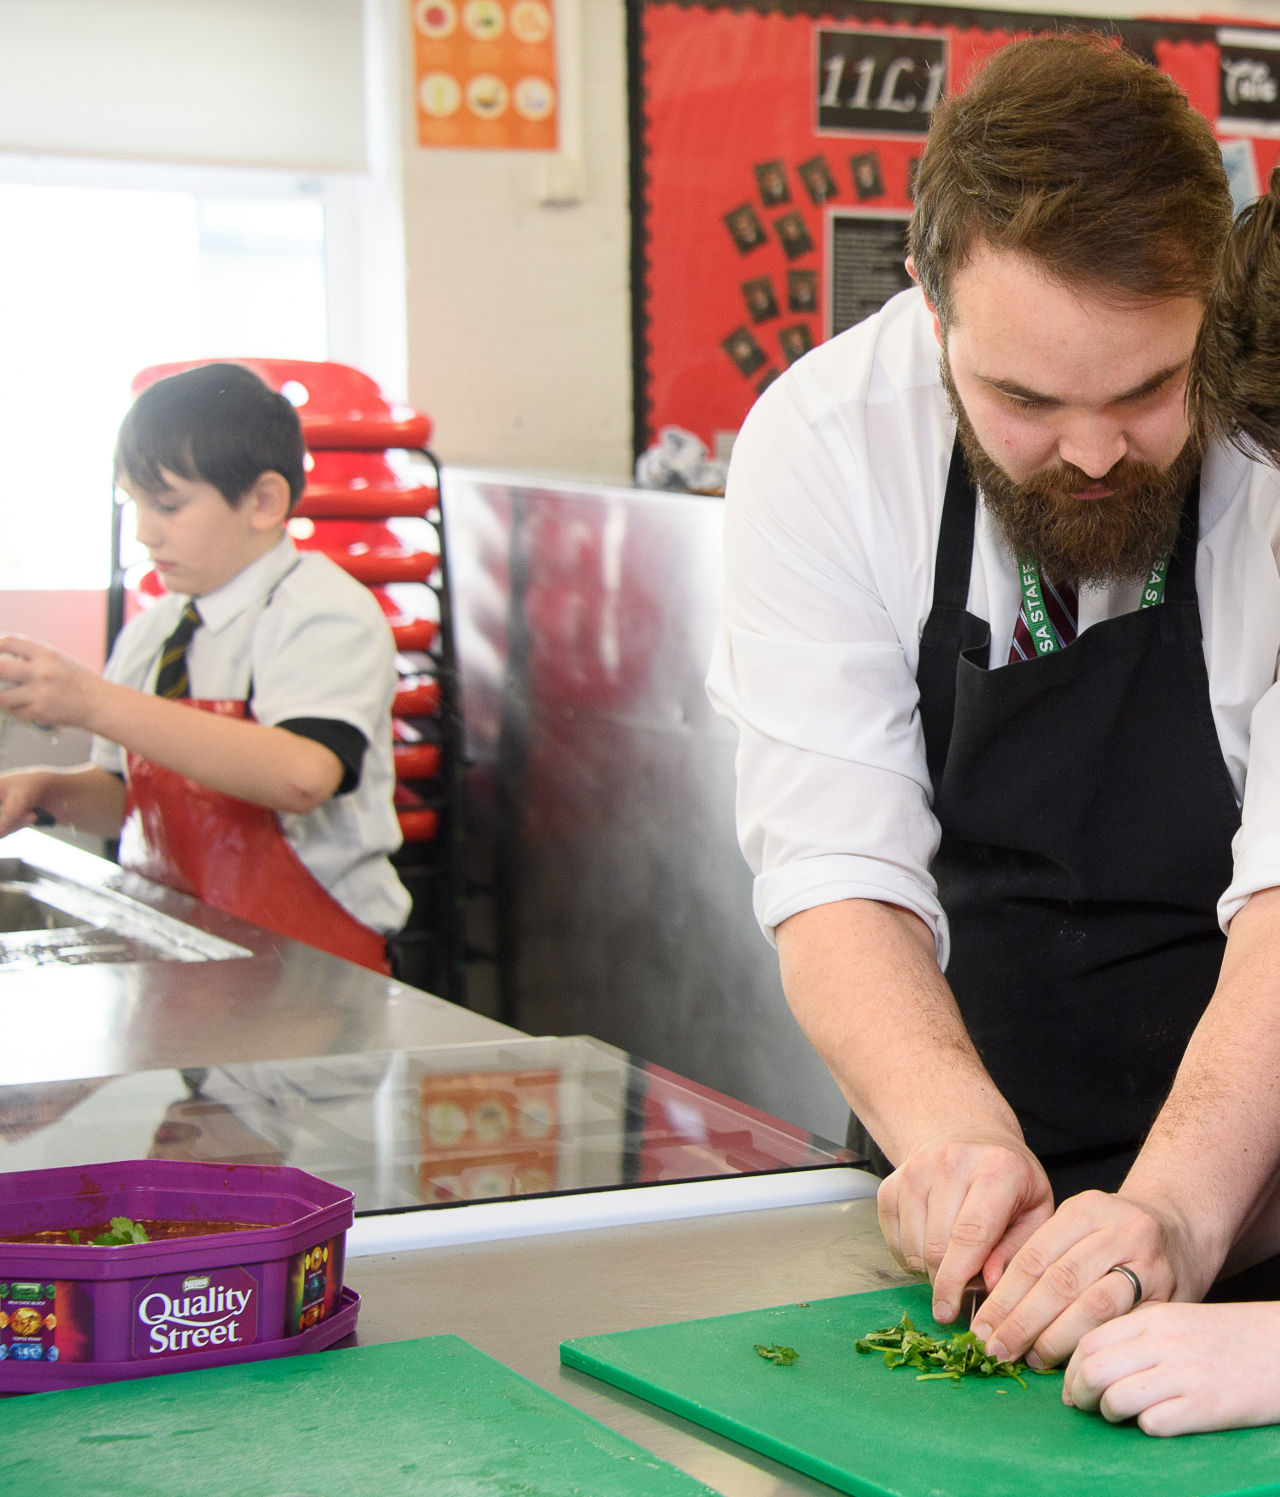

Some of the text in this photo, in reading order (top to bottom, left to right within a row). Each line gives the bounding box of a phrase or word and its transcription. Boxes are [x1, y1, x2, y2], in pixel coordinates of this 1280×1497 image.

[1022, 564, 1054, 653] SA STAFF
[138, 1285, 253, 1327] Quality
[149, 1320, 240, 1354] Street
